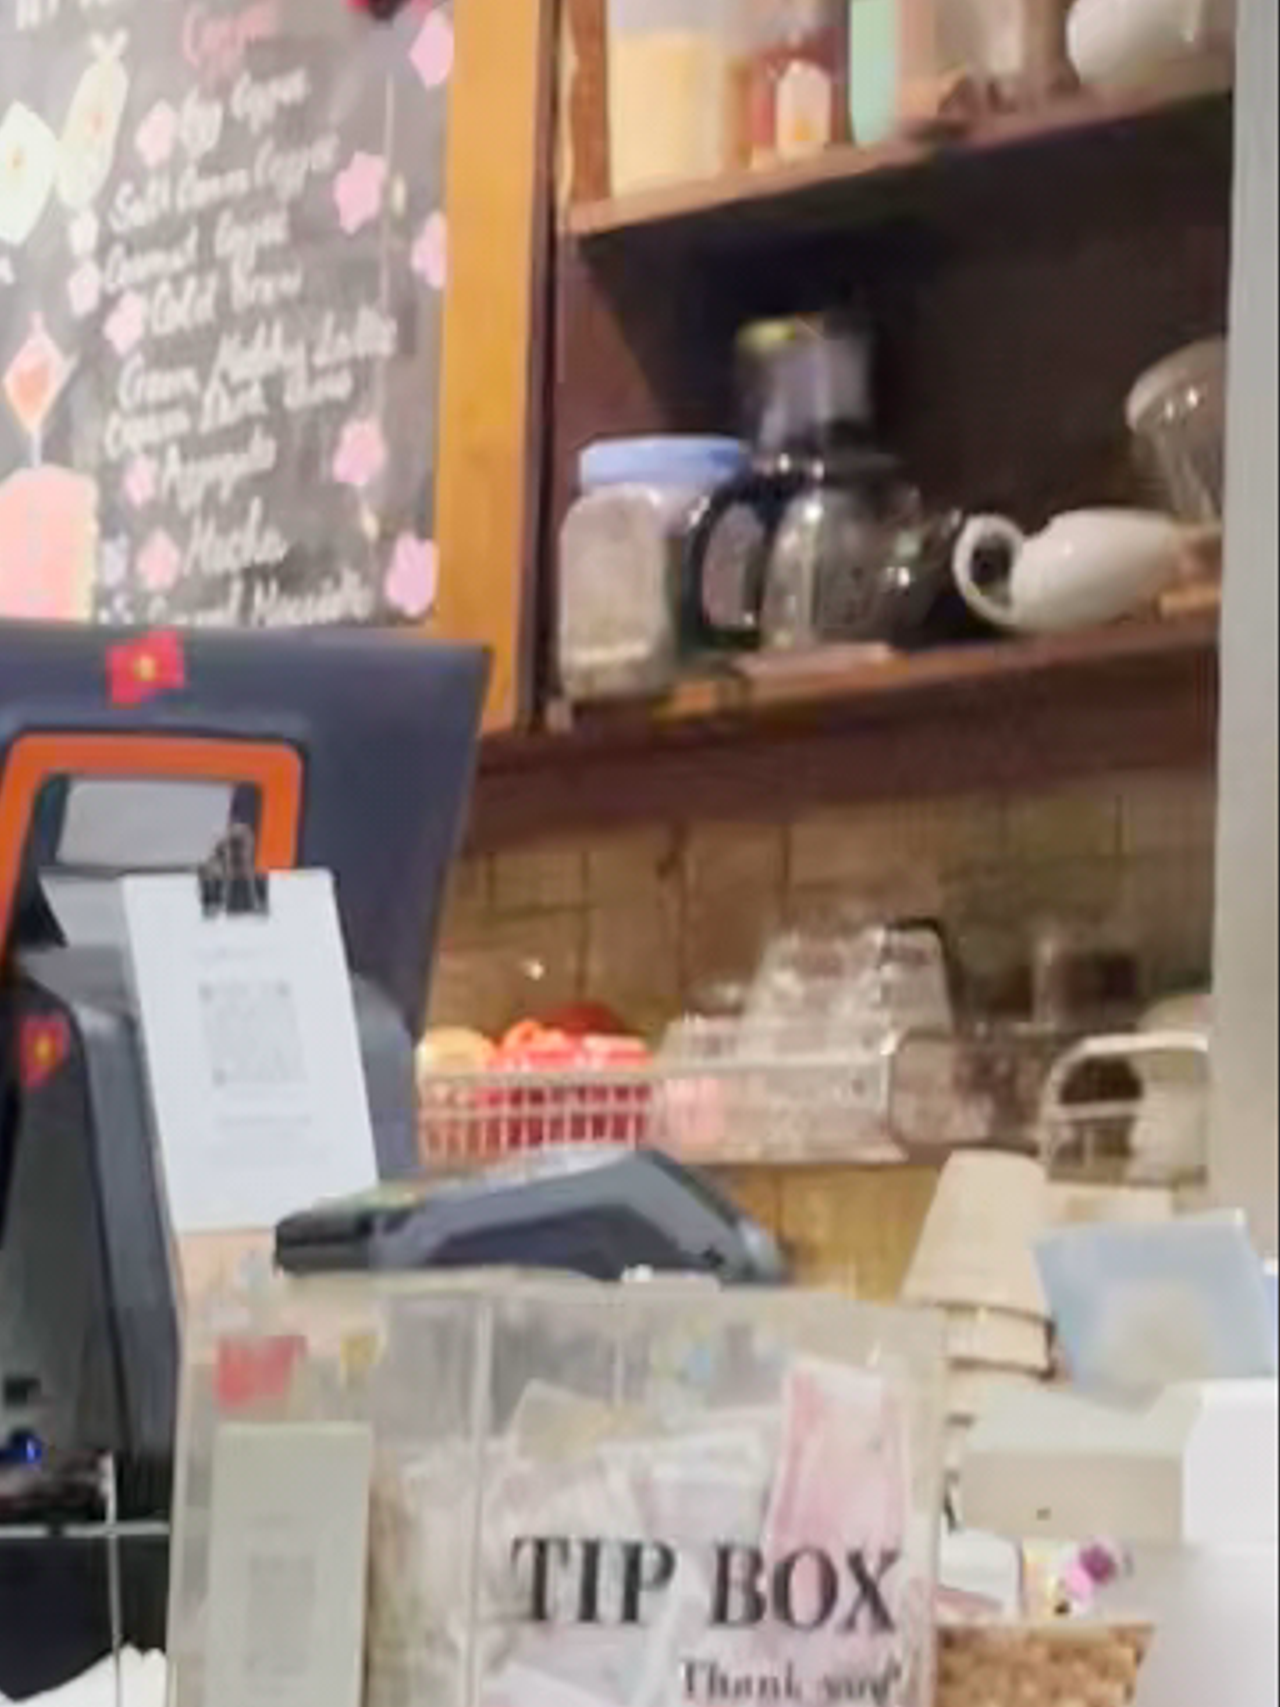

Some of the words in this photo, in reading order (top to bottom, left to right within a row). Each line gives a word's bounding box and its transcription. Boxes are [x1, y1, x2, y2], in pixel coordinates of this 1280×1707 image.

[510, 1536, 677, 1624] TIP
[708, 1542, 901, 1634] BOX
[682, 1657, 804, 1701] Thank
